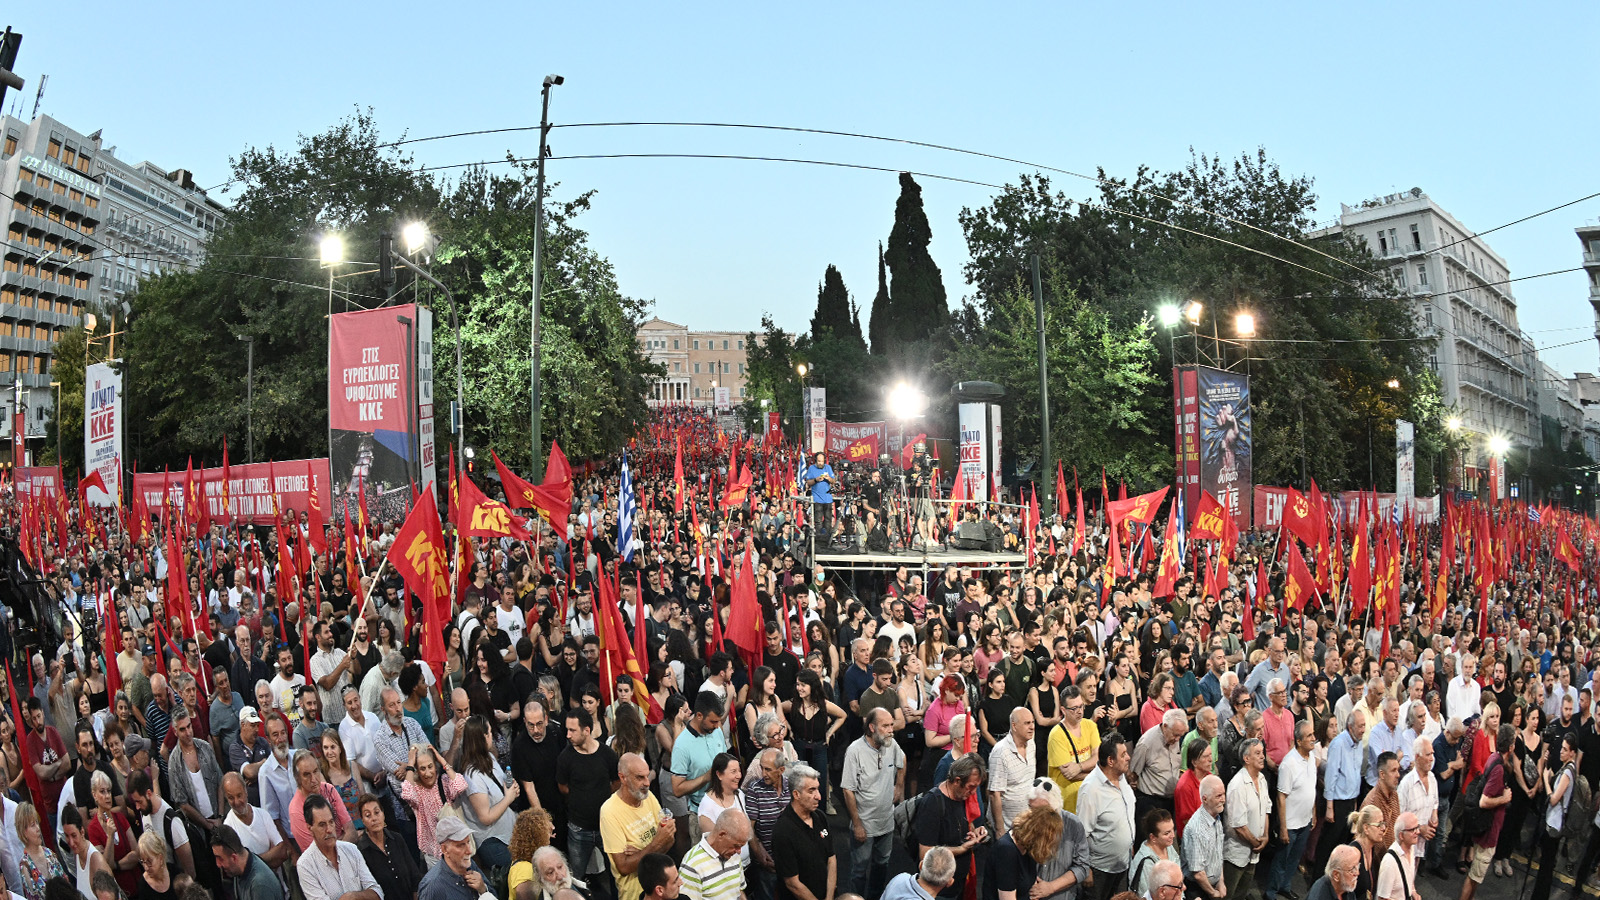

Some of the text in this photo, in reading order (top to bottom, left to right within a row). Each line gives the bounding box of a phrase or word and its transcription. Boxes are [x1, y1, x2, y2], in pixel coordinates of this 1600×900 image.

[362, 347, 379, 364] ΣΤΙΣ
[343, 364, 400, 384] ΕΥΡΩΕΚΛΟΓΕΣ
[91, 385, 115, 410] ΔΥΝΑΤΟ
[345, 383, 398, 402] ΨΗΦΙΖΟΥΜΕ
[359, 402, 384, 422] ΚΚΕ
[91, 411, 115, 438] ΚΚΕ
[470, 504, 511, 534] ΚΚΕ
